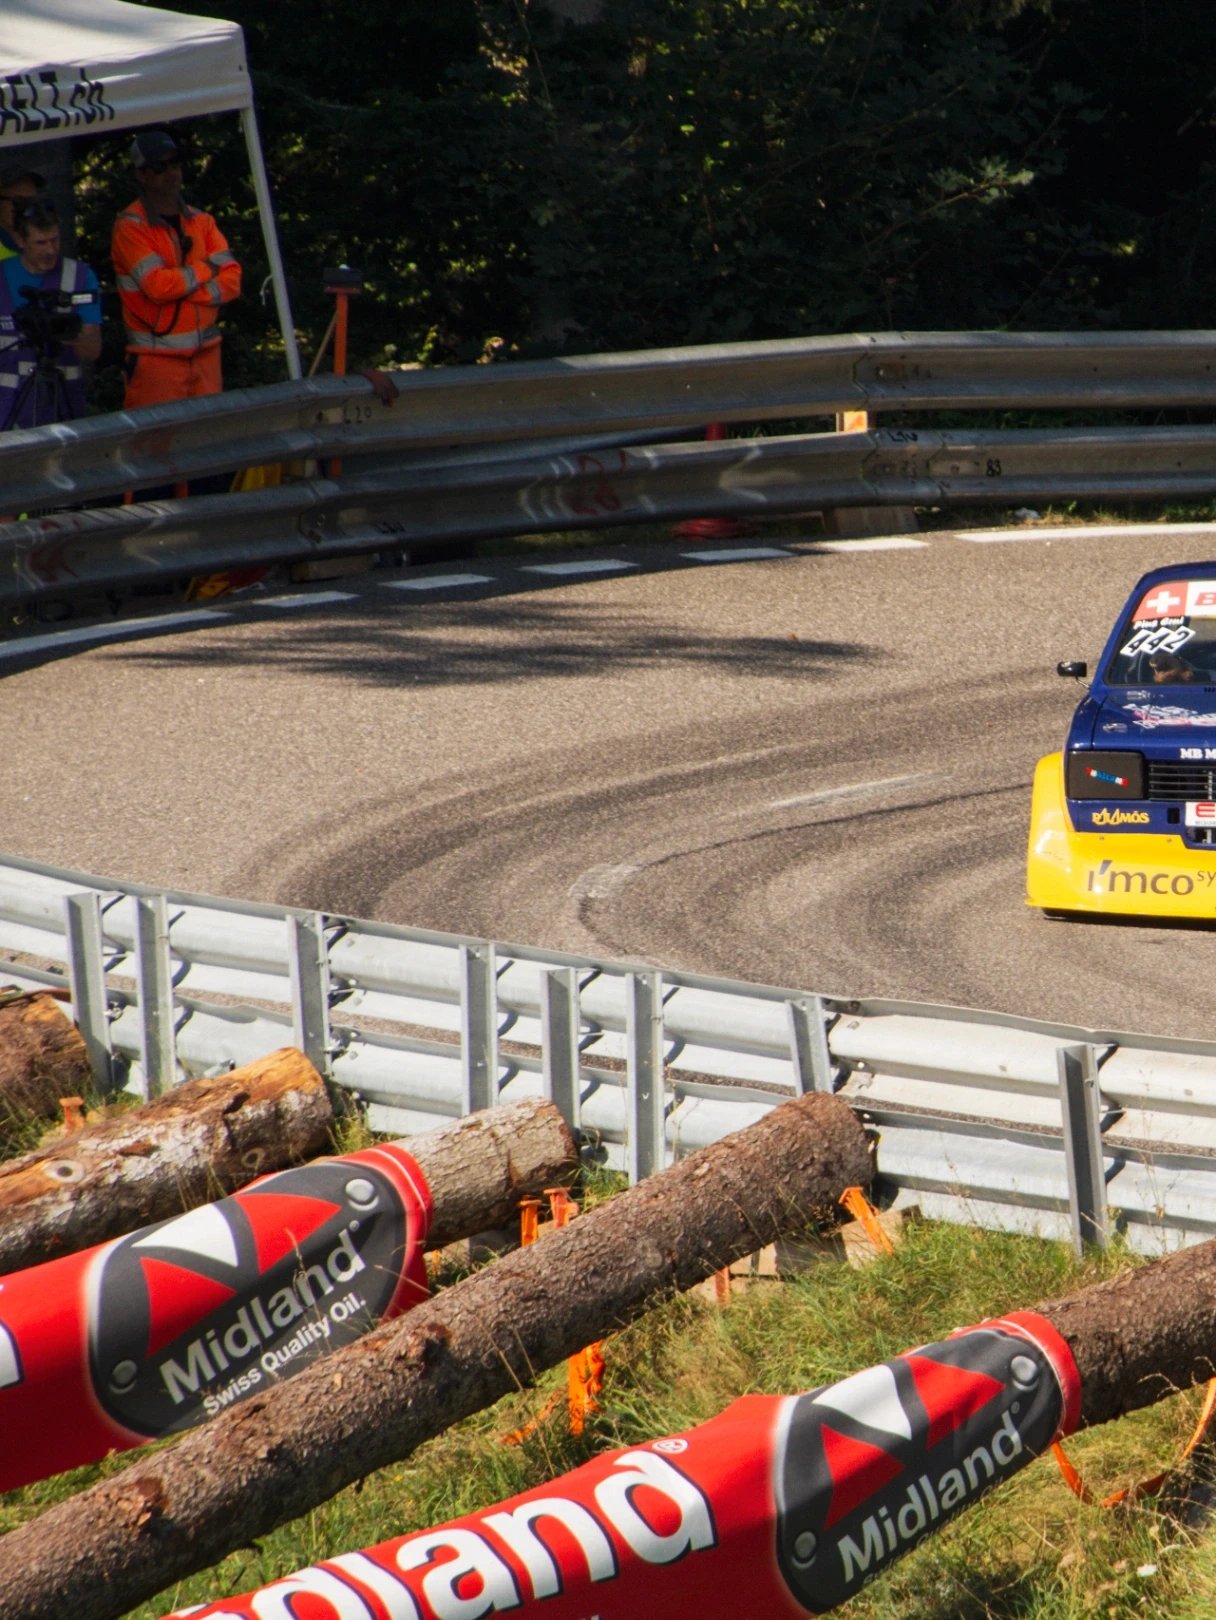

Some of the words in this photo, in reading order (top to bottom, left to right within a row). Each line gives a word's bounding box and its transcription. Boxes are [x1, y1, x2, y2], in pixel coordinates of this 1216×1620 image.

[1126, 629, 1192, 654] 442
[1180, 748, 1203, 760] MB
[159, 1228, 367, 1405] Midland
[202, 1366, 262, 1415] Swiss
[260, 1315, 332, 1374] Quality
[329, 1292, 367, 1323] Oil.
[837, 1410, 1023, 1583] Midland
